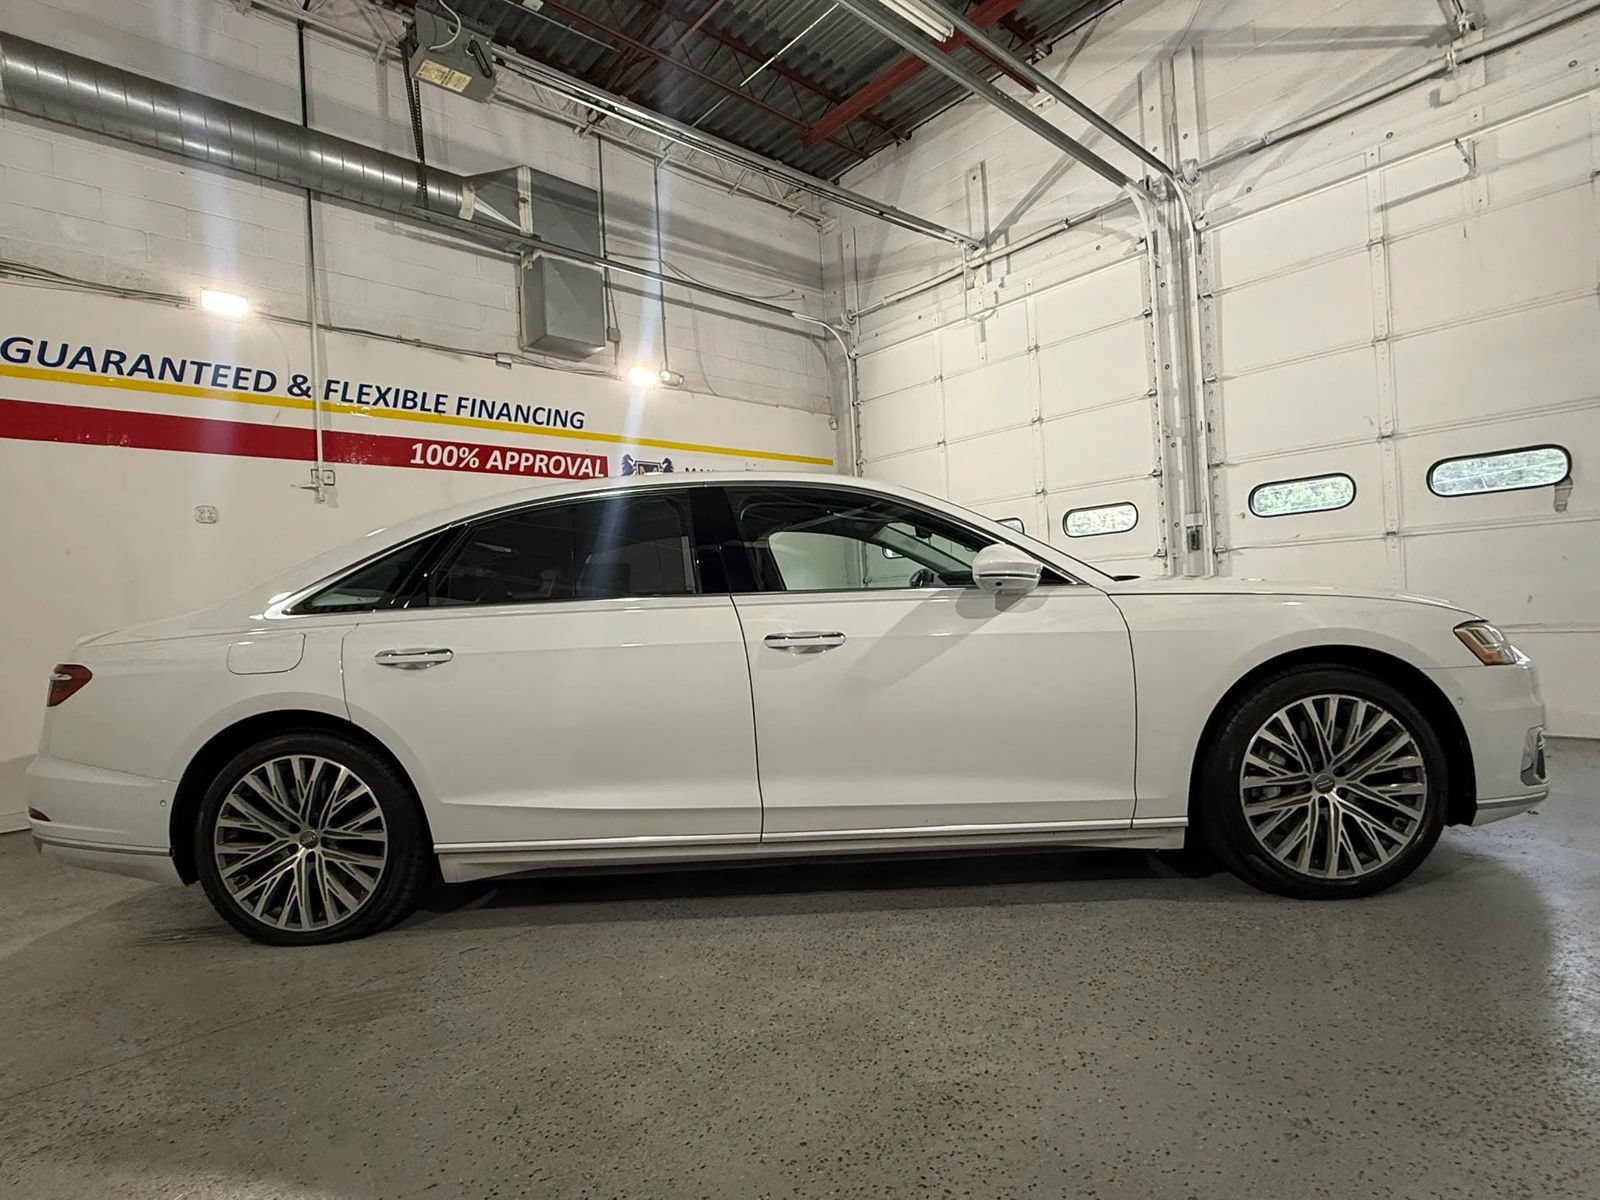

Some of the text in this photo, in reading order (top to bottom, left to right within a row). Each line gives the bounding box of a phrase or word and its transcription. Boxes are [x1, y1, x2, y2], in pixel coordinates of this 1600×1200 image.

[0, 337, 585, 430] GUARANTEED & FLEXIBLE FINANCING
[410, 443, 605, 478] 100% APPROVAL
